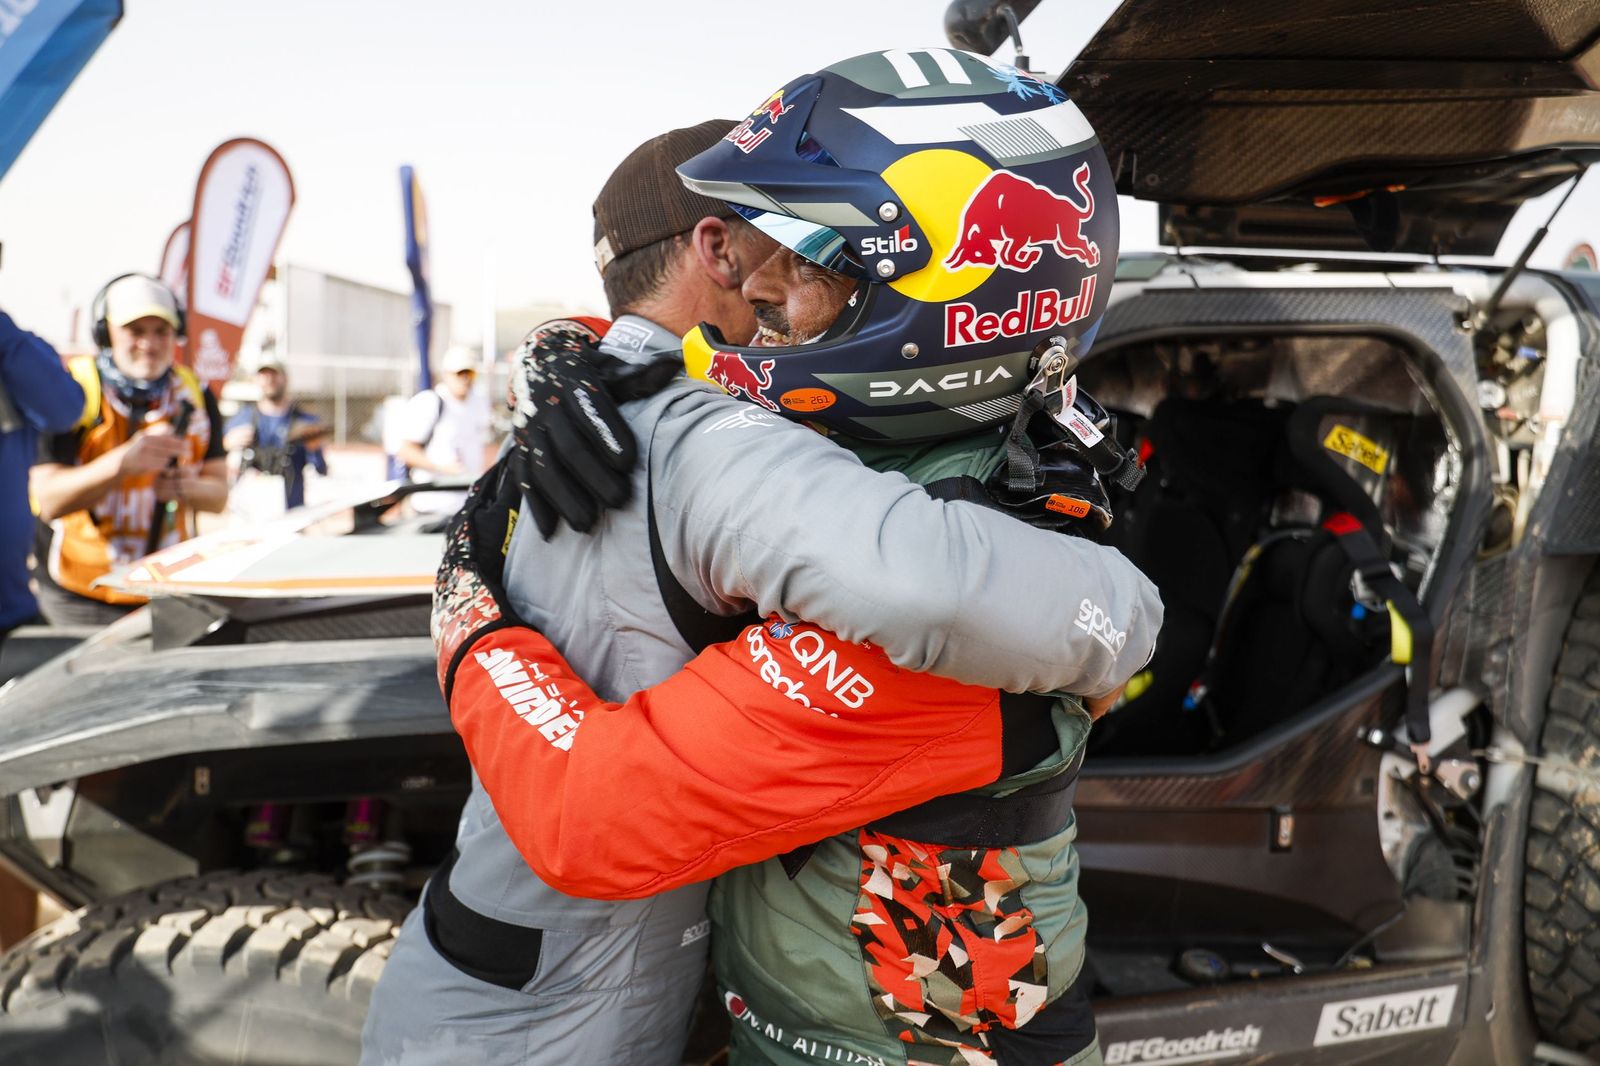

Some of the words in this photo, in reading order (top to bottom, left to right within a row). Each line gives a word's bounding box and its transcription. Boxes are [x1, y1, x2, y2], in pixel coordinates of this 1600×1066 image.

[860, 228, 918, 255] Stilo
[944, 290, 1031, 348] Red
[1030, 274, 1097, 333] Bull
[810, 394, 831, 405] 261
[869, 365, 1013, 398] DACIA
[1068, 505, 1086, 515] 106
[790, 630, 875, 709] QNB
[1332, 994, 1440, 1038] Sabelt
[1104, 1023, 1264, 1065] BFGoodrich
